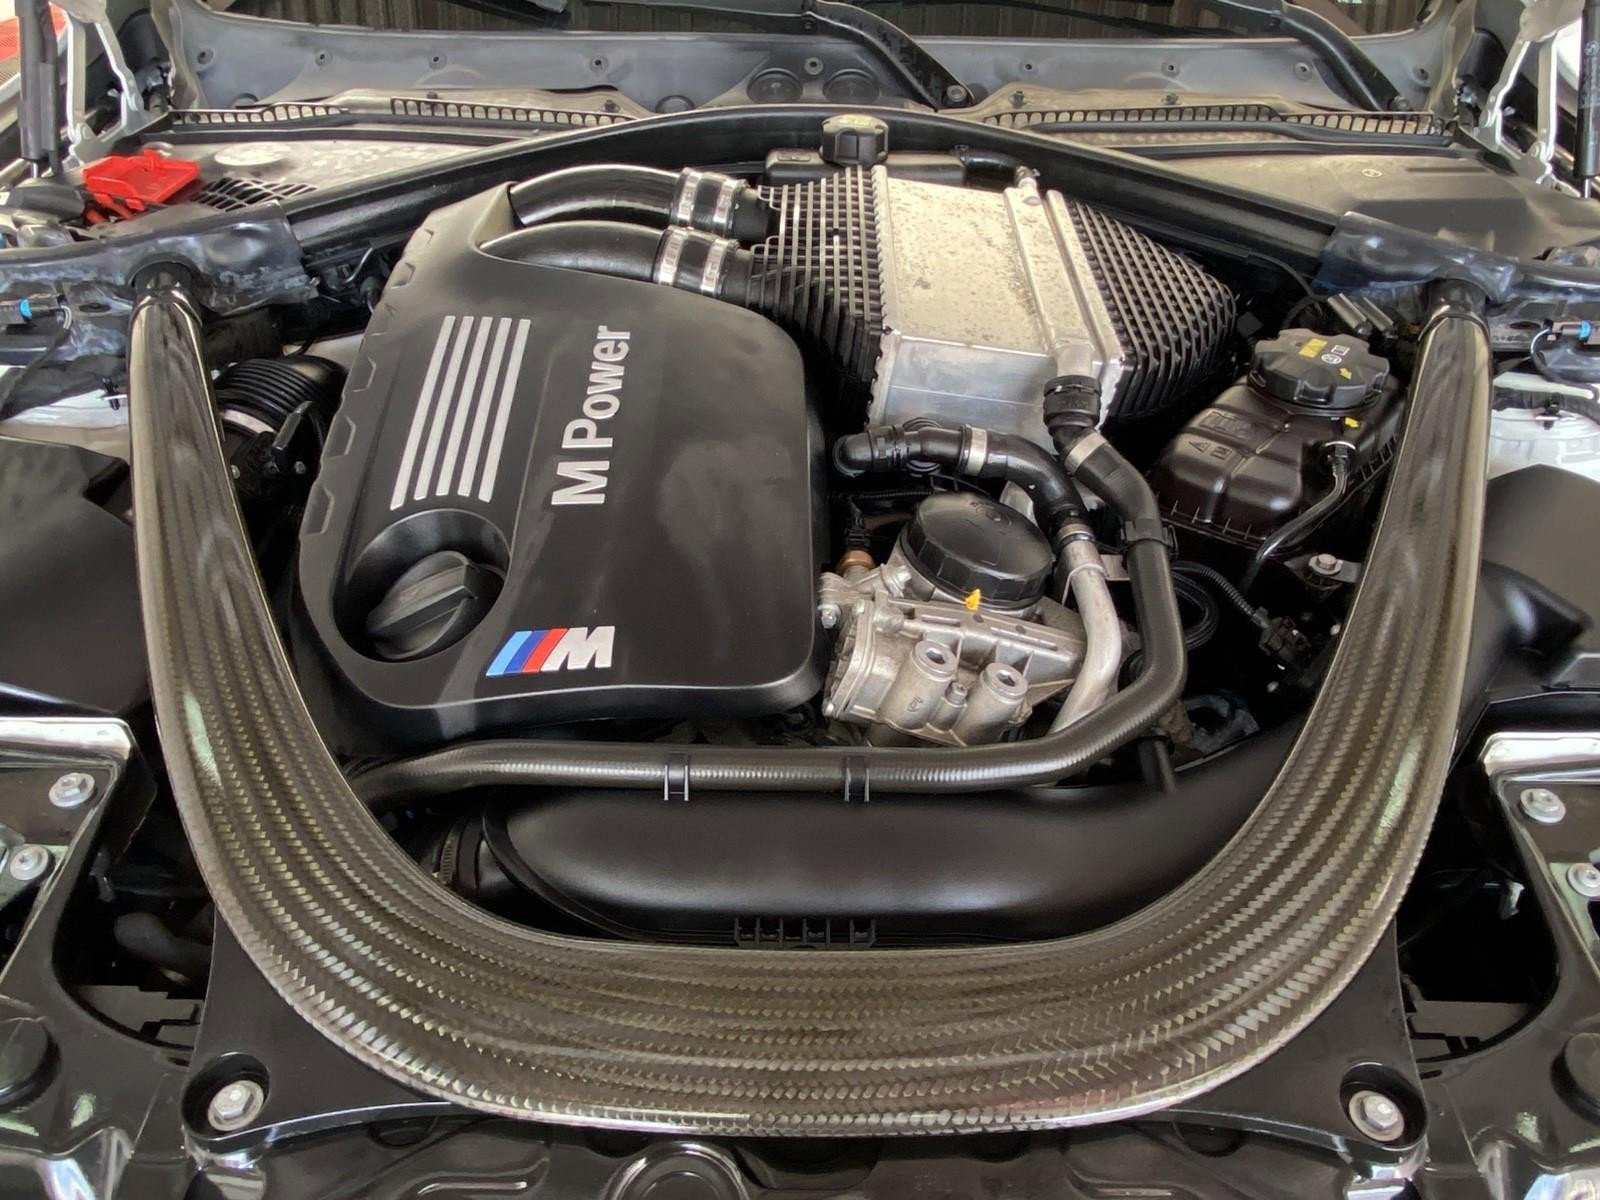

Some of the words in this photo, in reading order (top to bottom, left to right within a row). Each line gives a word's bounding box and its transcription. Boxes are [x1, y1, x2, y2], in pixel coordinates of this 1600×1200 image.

[561, 325, 631, 449] Power
[551, 460, 610, 506] M
[540, 625, 616, 672] M
